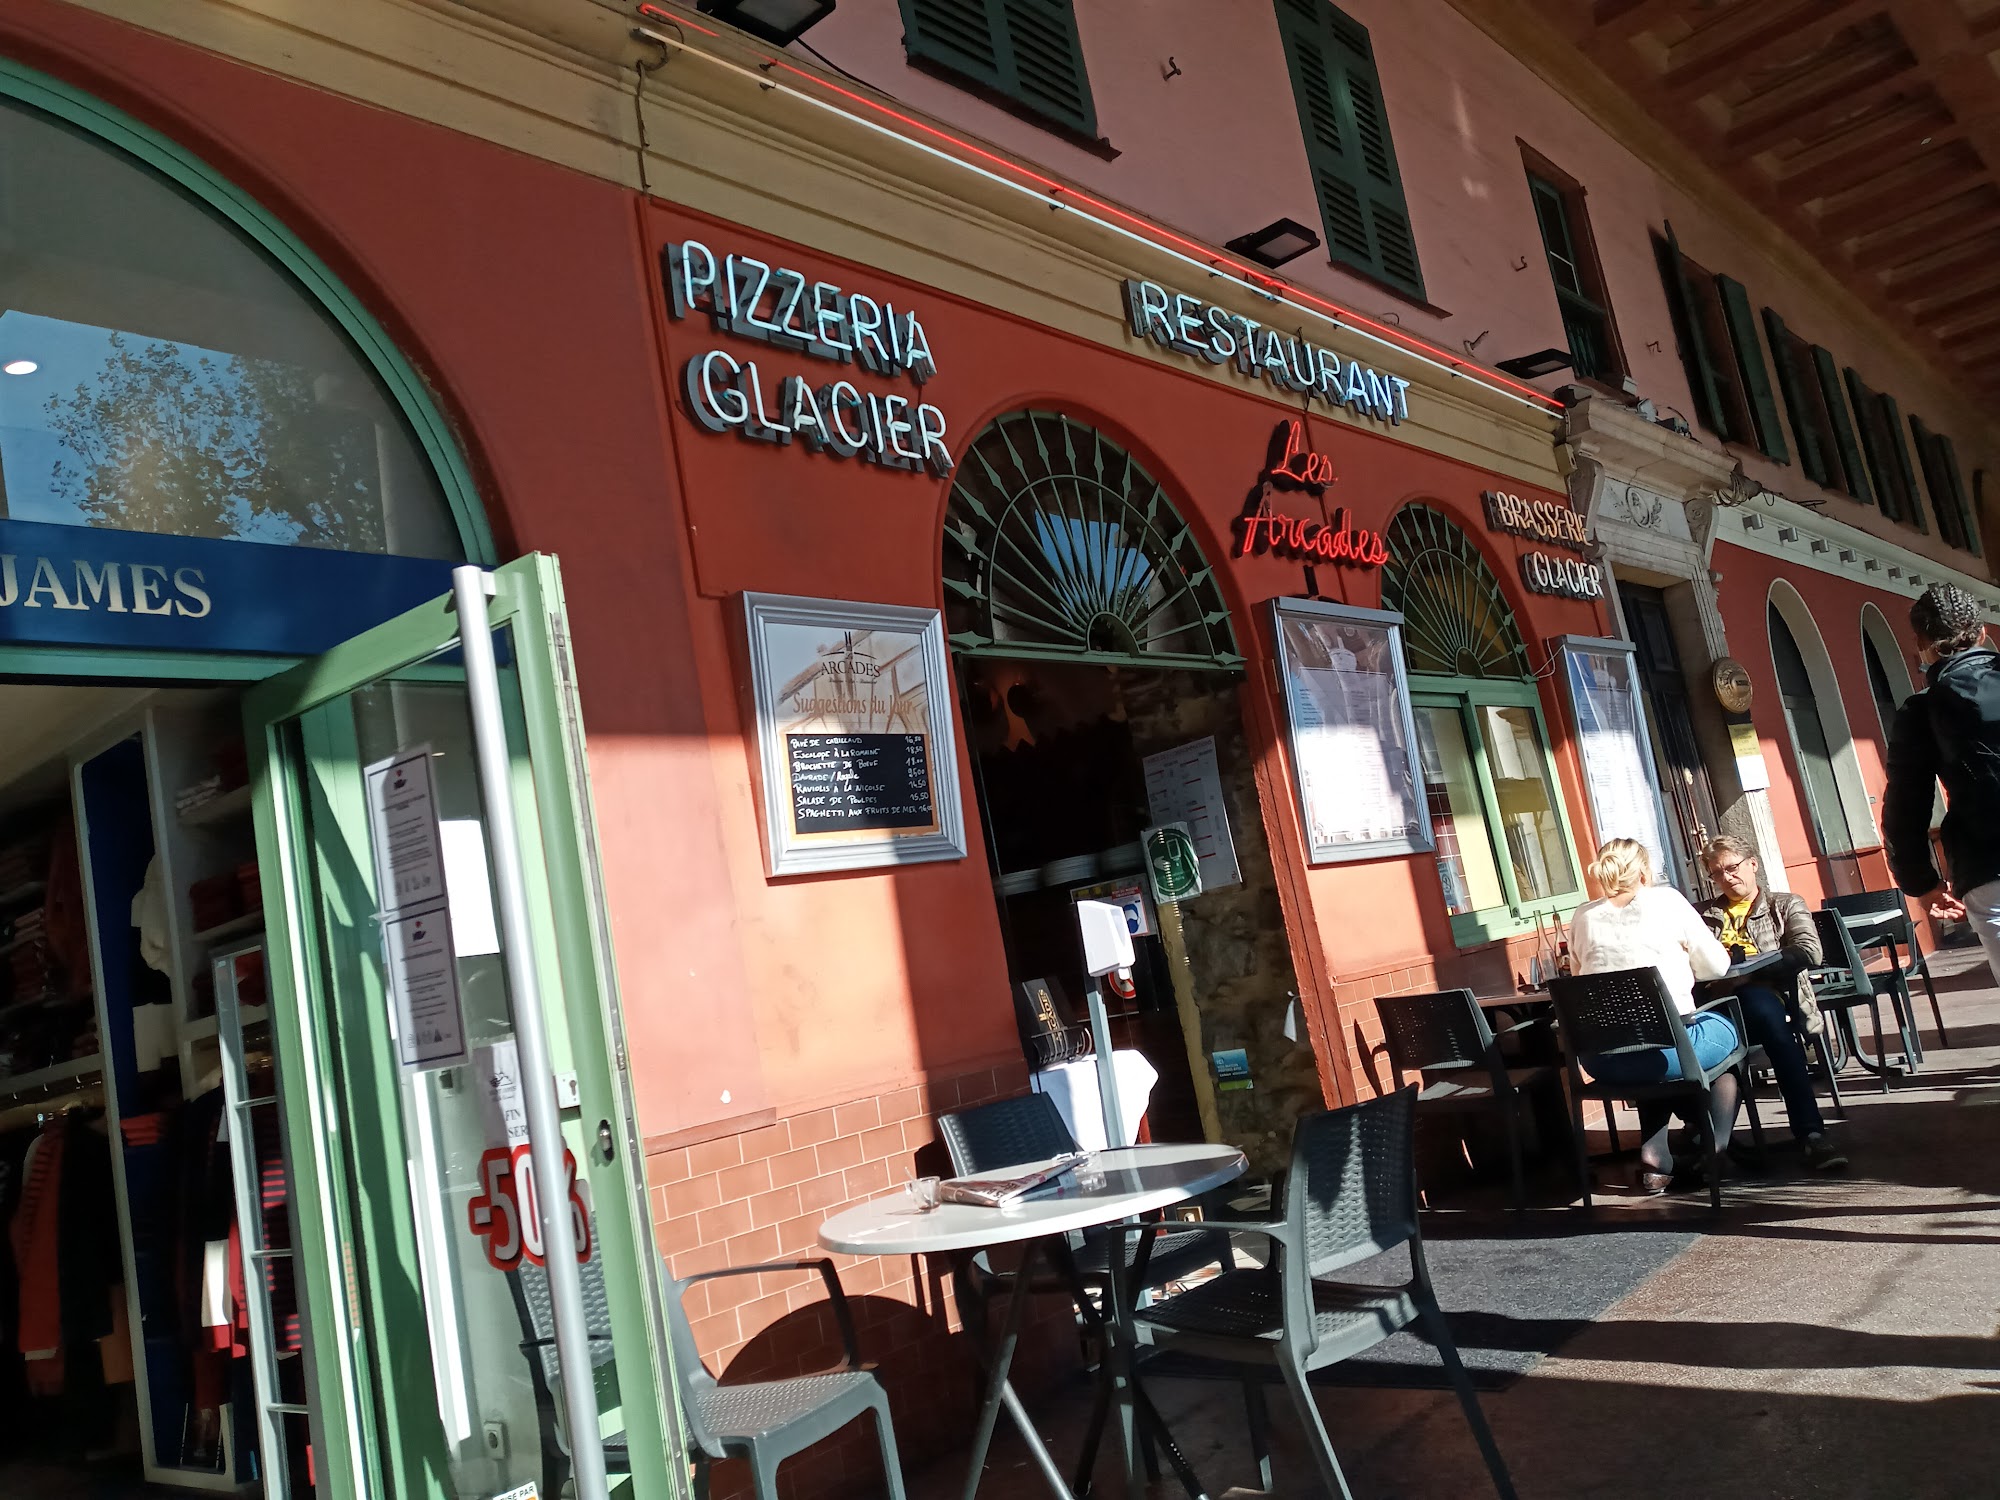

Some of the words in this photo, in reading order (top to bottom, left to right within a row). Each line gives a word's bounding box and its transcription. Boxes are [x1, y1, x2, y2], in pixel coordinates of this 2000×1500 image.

[680, 239, 938, 376] PIZZERIA
[1137, 279, 1411, 420] RESTAURANT
[700, 349, 955, 468] GLACIER
[1271, 420, 1338, 484] Les
[1242, 484, 1390, 566] Arcades
[1495, 490, 1594, 548] BRASSERIE
[1531, 550, 1605, 599] GLACIER
[0, 553, 212, 619] JAMES
[820, 660, 881, 679] ARCADES
[793, 692, 867, 719] Suggestions
[871, 696, 886, 714] du
[809, 739, 820, 747] DE
[825, 737, 863, 745] CABILLAUD
[834, 747, 840, 758] À
[841, 750, 850, 758] LA
[850, 748, 881, 757] ROMAINE
[792, 760, 837, 773] BROCHETTE
[842, 760, 853, 770] DE
[791, 772, 829, 782] DAURADE
[792, 782, 830, 794] RAVIOLIS
[844, 784, 852, 793] LA
[795, 795, 826, 807] SALADE
[829, 796, 843, 806] DE
[797, 808, 845, 820] SPAGHETTI
[847, 808, 863, 818] AUX
[864, 806, 890, 815] FRUITS
[891, 806, 901, 814] DE
[902, 805, 917, 814] MER
[505, 1108, 521, 1122] FIN
[519, 1485, 535, 1498] PAR
